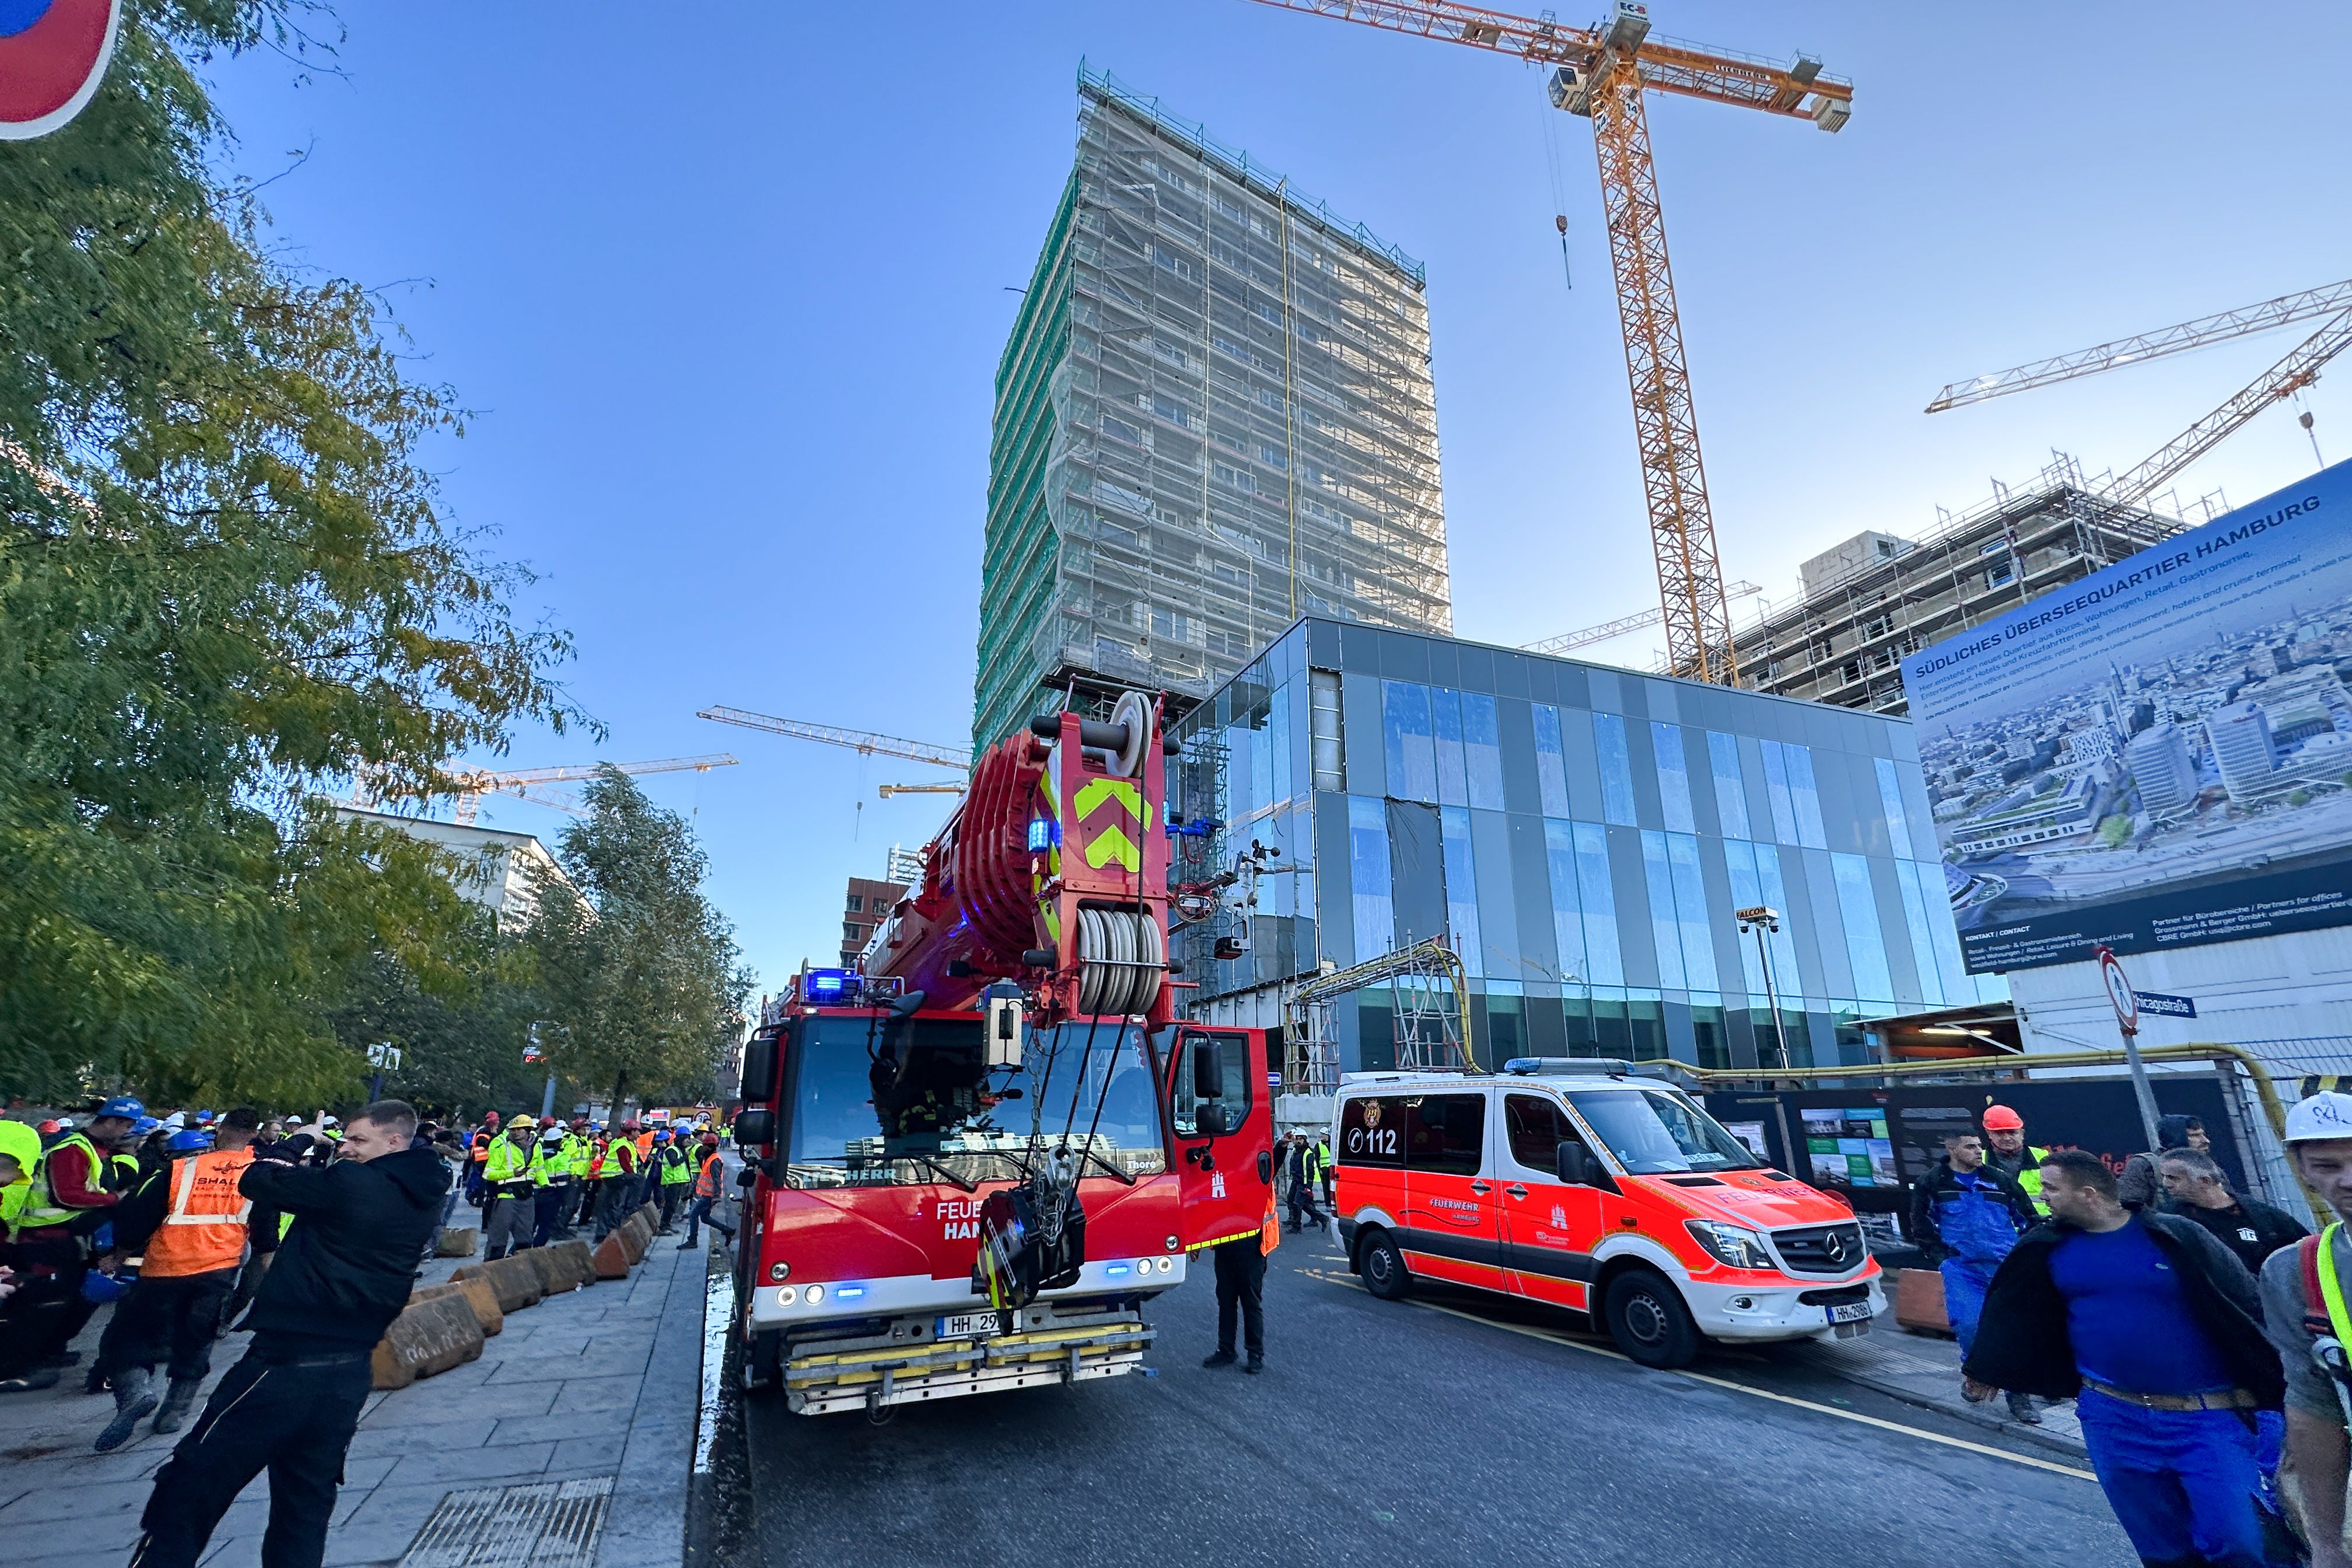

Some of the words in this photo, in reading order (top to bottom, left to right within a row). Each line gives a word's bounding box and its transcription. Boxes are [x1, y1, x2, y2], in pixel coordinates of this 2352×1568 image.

[1625, 103, 1639, 114] 14
[1916, 634, 2002, 678] SÜDLICHES
[2005, 552, 2192, 640] ÜBERSEEQUARTIER
[2195, 496, 2320, 559] HAMBURG
[1929, 699, 1943, 708] new
[1943, 689, 1967, 704] quarter
[1968, 682, 1983, 694] with
[2172, 596, 2201, 611] hotels
[2203, 585, 2222, 599] and
[2224, 574, 2255, 591] cruise
[2256, 554, 2301, 579] terminal
[1920, 675, 1974, 701] Entertainment,
[1975, 665, 2001, 678] Hotels
[2002, 657, 2018, 668] und
[2018, 622, 2101, 660] Kreuzfahrtterminal
[1935, 669, 1965, 687] entsteht
[1966, 664, 1978, 673] ein
[1979, 655, 2003, 668] neues
[2003, 640, 2036, 658] Quartier
[2039, 632, 2054, 643] aus
[1934, 705, 1958, 718] PROJEKT
[1958, 701, 1969, 709] DER
[1978, 688, 2003, 701] PROJECT
[1736, 906, 1766, 920] FALCON
[2152, 916, 2181, 927] Partner
[2182, 914, 2194, 922] für
[2195, 905, 2250, 921] Bürobereiche
[2257, 899, 2295, 911] Partners
[2297, 896, 2309, 905] for
[2311, 891, 2343, 902] offices
[1965, 931, 1994, 942] KONTAKT
[1999, 925, 2031, 936] CONTACT
[2154, 922, 2199, 934] Grossmann
[2208, 916, 2236, 928] Berger
[2156, 933, 2179, 942] CBRE
[2208, 920, 2272, 935] usq@cbre.com
[1987, 950, 2021, 961] Wohnungen
[2046, 942, 2070, 951] Leisure
[2077, 937, 2098, 947] Dining
[2098, 935, 2112, 943] and
[2113, 932, 2134, 941] Living
[2134, 993, 2189, 1013] hicagostraße
[1366, 1129, 1396, 1154] 112
[1126, 1160, 1156, 1169] Thore
[197, 1177, 236, 1185] SHAL
[803, 1168, 897, 1183] LIEHERR
[936, 1200, 984, 1220] FEUE
[1430, 1198, 1480, 1212] FEUERWEHR
[951, 1317, 971, 1333] HH
[979, 1314, 998, 1330] 29
[1836, 1307, 1849, 1320] HH
